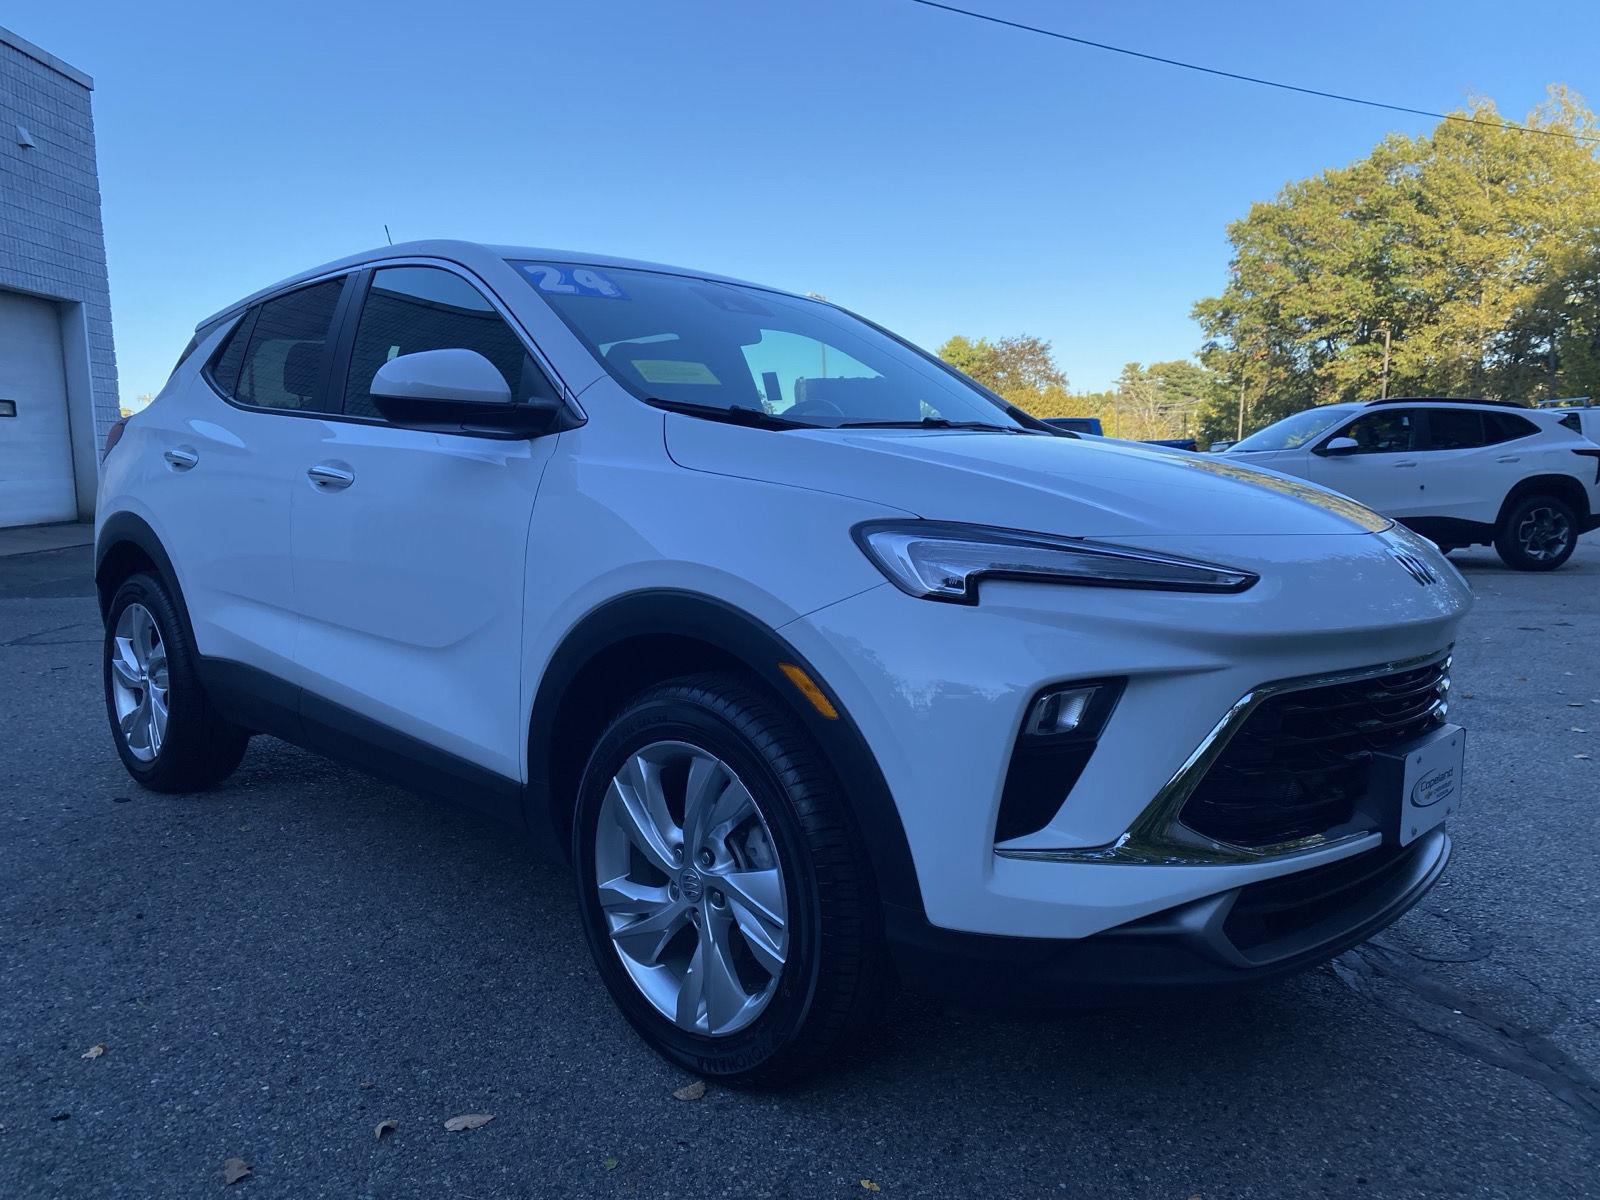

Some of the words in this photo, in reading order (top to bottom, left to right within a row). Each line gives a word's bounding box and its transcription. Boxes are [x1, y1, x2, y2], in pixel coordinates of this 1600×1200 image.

[523, 265, 620, 297] 24
[1420, 767, 1454, 792] Copeland
[696, 1046, 771, 1073] YOKOHAMA
